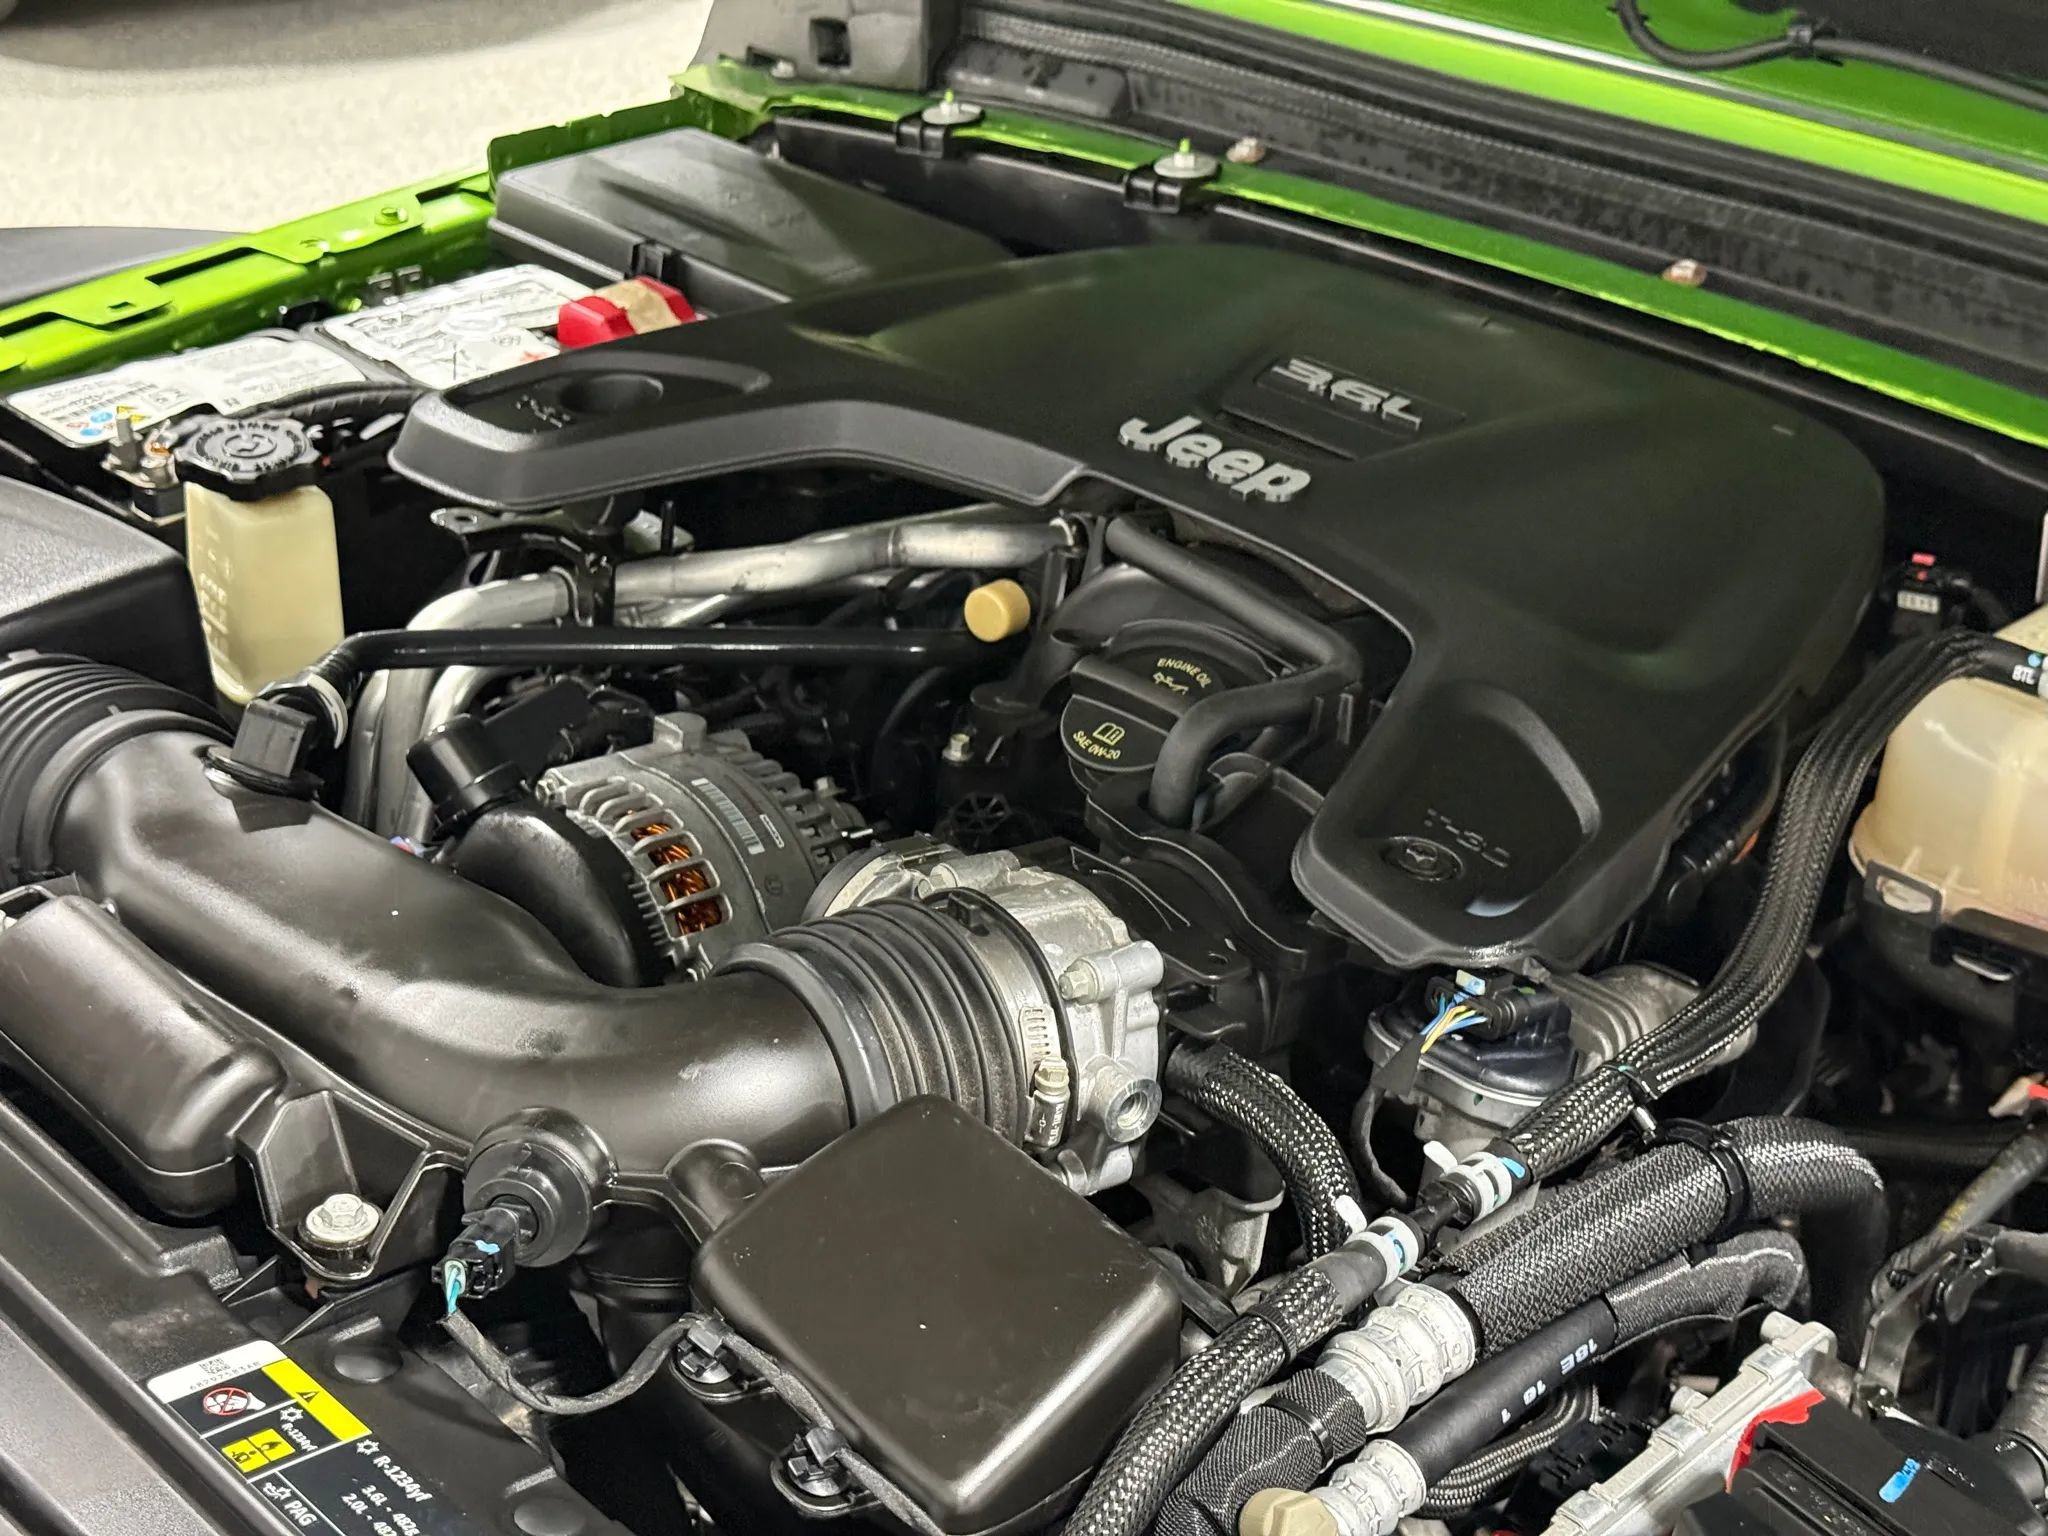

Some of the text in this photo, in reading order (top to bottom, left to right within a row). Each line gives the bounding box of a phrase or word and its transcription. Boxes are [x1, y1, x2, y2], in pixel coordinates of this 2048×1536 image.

[1118, 414, 1312, 503] Jeep
[1157, 657, 1212, 688] ENGINE OIL
[1073, 730, 1121, 760] SAE 0W-20
[373, 1455, 433, 1502] R-1234yf
[341, 1492, 369, 1515] 2.0L
[361, 1484, 388, 1507] 3.6L
[283, 1500, 318, 1527] PAG
